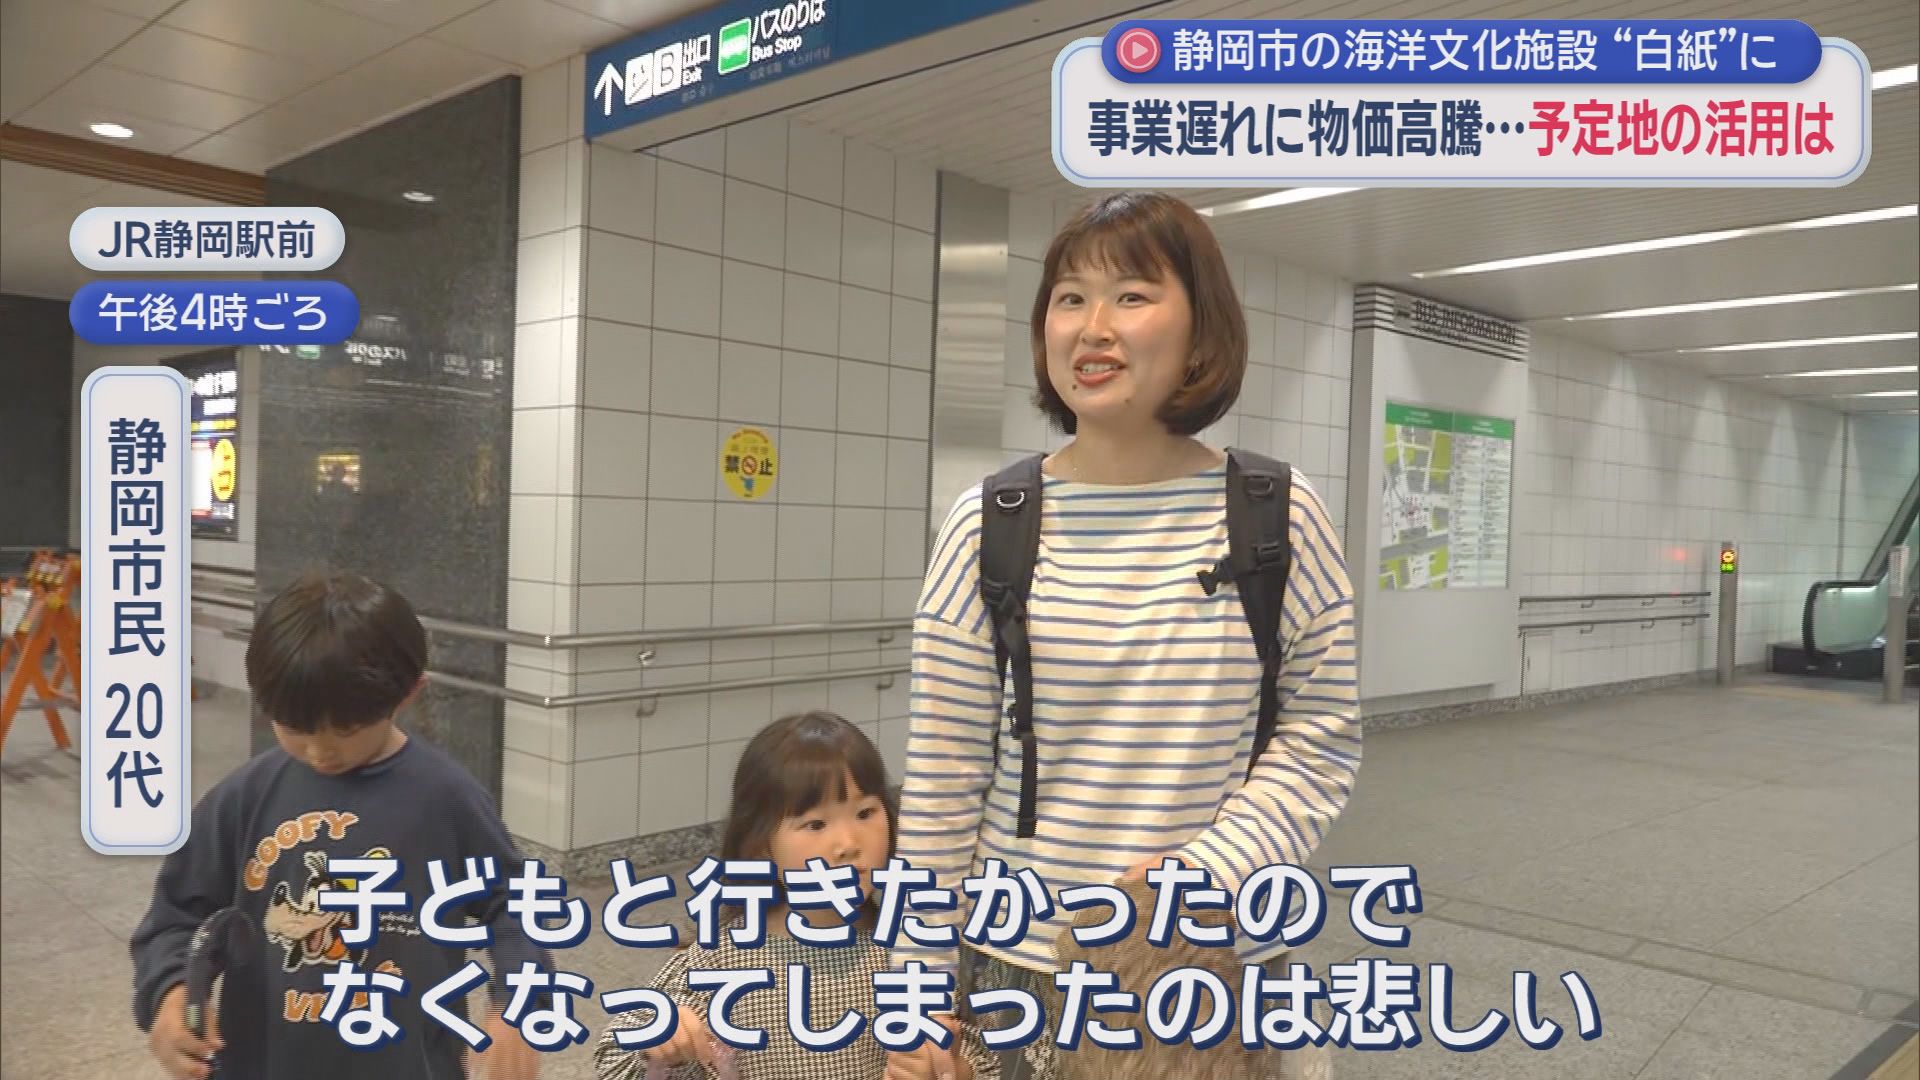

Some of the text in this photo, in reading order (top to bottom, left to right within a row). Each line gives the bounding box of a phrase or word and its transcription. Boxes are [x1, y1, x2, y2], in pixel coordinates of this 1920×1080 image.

[752, 0, 826, 42] バスのりば
[683, 34, 711, 67] 出口
[752, 44, 773, 62] Bus
[774, 34, 803, 55] Stop
[682, 68, 702, 86] Exit
[243, 809, 360, 893] GOOFY
